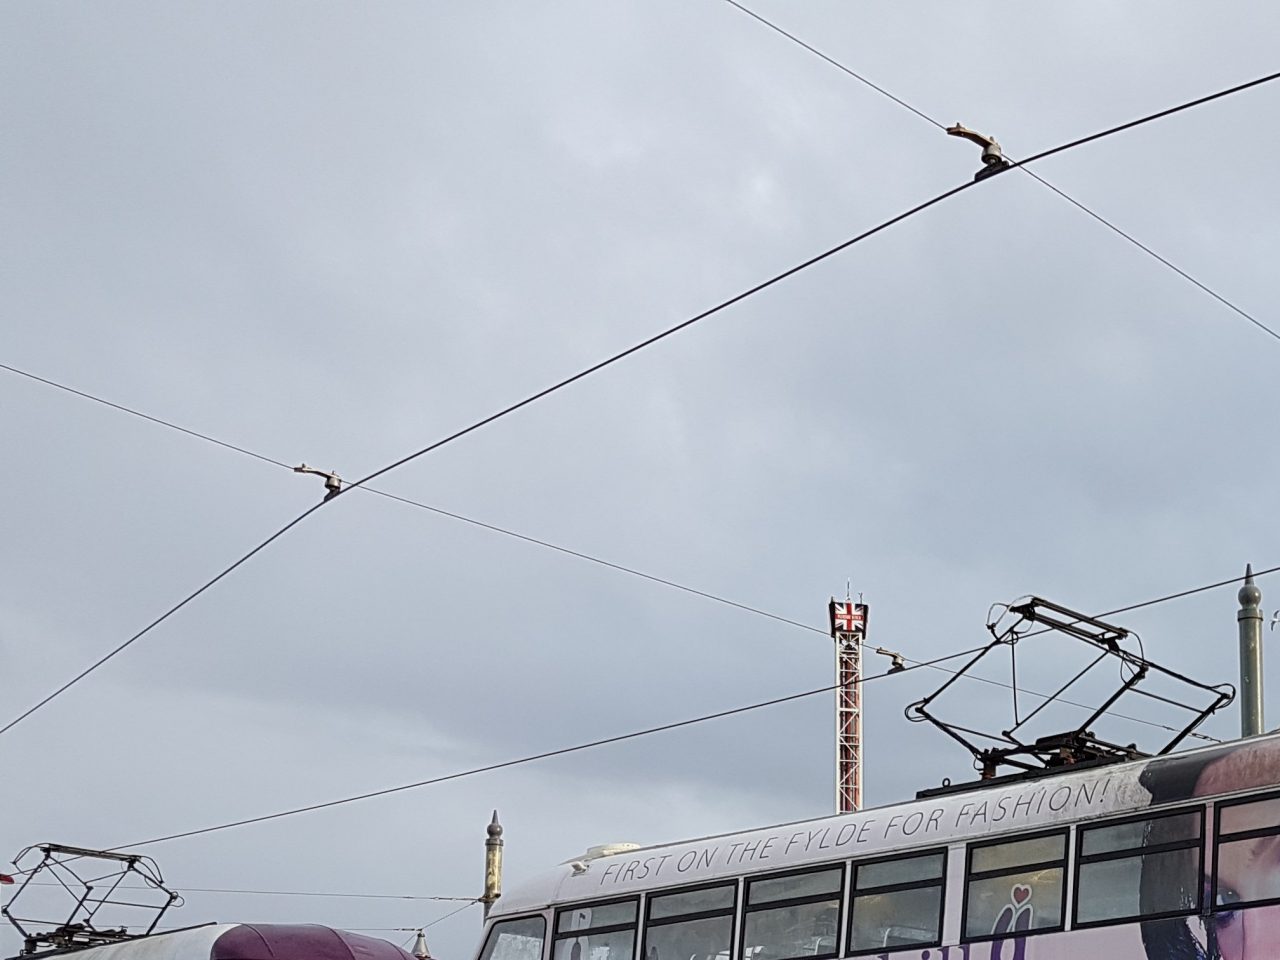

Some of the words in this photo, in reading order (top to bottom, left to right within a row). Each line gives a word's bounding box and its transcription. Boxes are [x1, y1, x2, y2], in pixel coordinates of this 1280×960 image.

[600, 854, 673, 886] FIRST
[677, 847, 719, 873] ON
[726, 837, 778, 865] THE
[784, 819, 877, 855] FYLDE
[883, 808, 945, 839] FOR
[954, 778, 1111, 828] FASHION!
